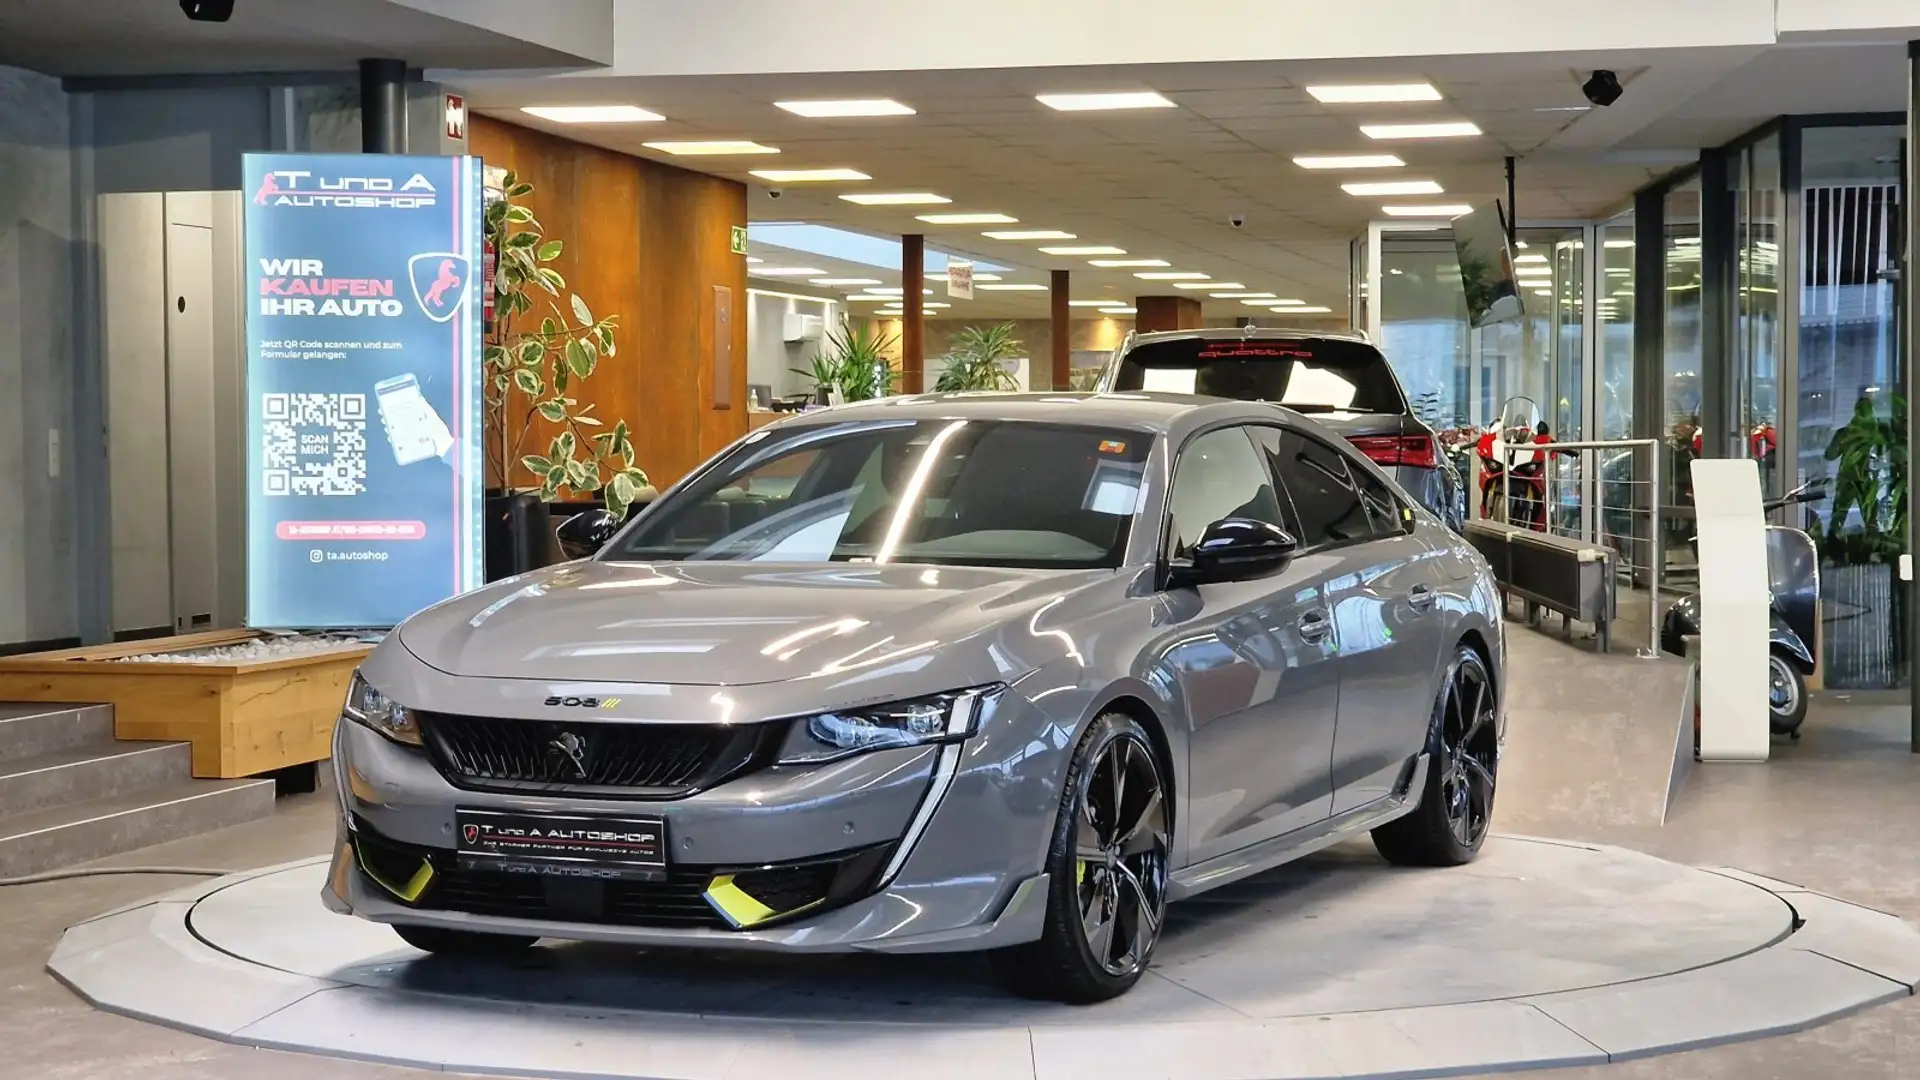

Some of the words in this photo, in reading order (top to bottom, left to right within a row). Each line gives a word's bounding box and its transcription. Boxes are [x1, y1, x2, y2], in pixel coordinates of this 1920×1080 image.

[274, 170, 311, 189] T
[400, 173, 436, 192] A
[274, 195, 436, 209] AUTOSHOP
[259, 258, 323, 276] WIR
[260, 278, 394, 297] KAUFEN
[260, 298, 316, 316] IHR
[318, 299, 404, 317] AUTO
[260, 340, 283, 349] Jetzt
[283, 340, 298, 350] QR
[299, 340, 323, 349] Code
[324, 341, 362, 350] scannen
[363, 340, 381, 350] und
[382, 342, 403, 350] zum
[260, 350, 301, 359] Formular
[302, 350, 347, 360] gelangen:
[1198, 349, 1313, 359] quattro
[300, 434, 329, 444] SCAN
[300, 444, 329, 455] MICH
[326, 550, 389, 561] ta.autoshop
[480, 824, 494, 833] T
[529, 828, 542, 837] A
[547, 829, 655, 843] AUTOSHOP
[497, 863, 508, 872] T
[528, 865, 538, 874] A
[542, 866, 622, 879] AUTOSHOP
